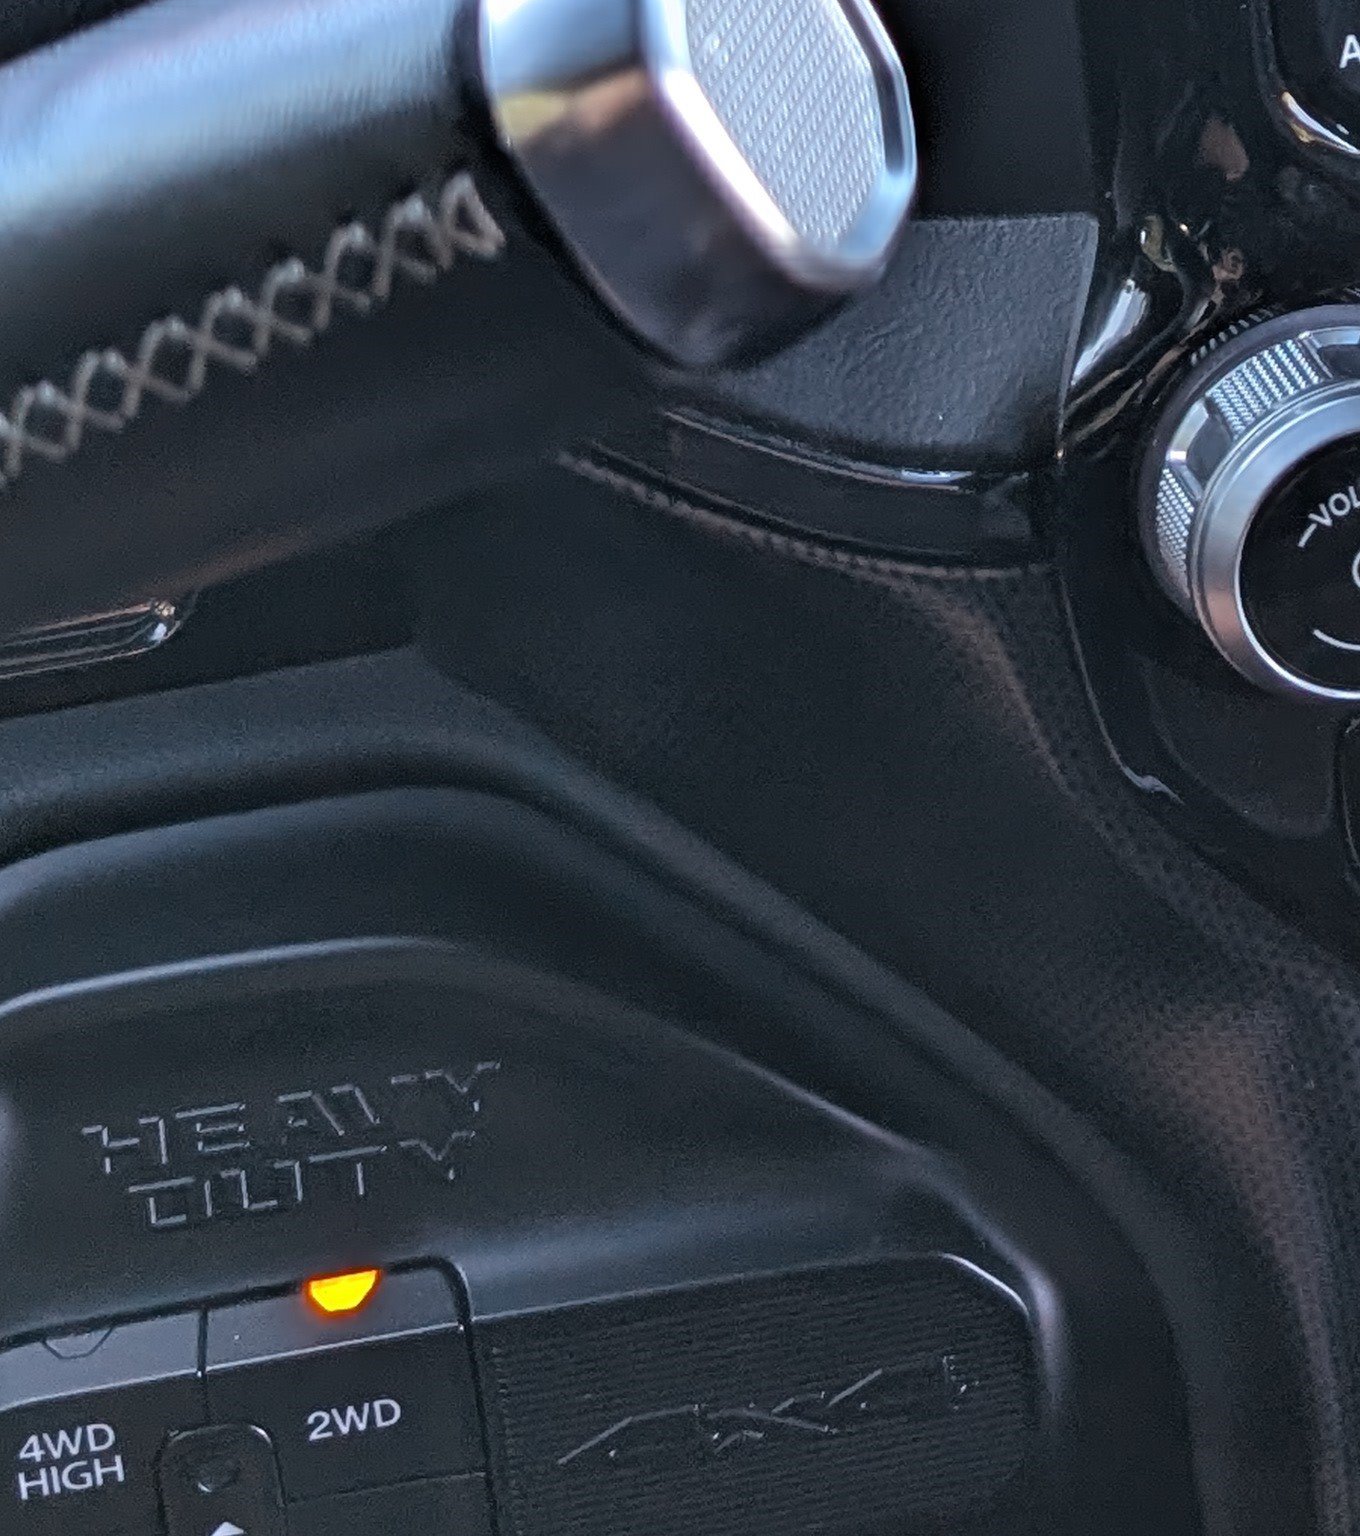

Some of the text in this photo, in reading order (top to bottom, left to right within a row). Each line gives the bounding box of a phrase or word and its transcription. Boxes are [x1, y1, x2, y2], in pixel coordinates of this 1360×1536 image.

[80, 1060, 502, 1176] HEAVY
[306, 1398, 402, 1442] 2WD
[18, 1423, 117, 1463] 4WD
[17, 1454, 125, 1500] HIGH
